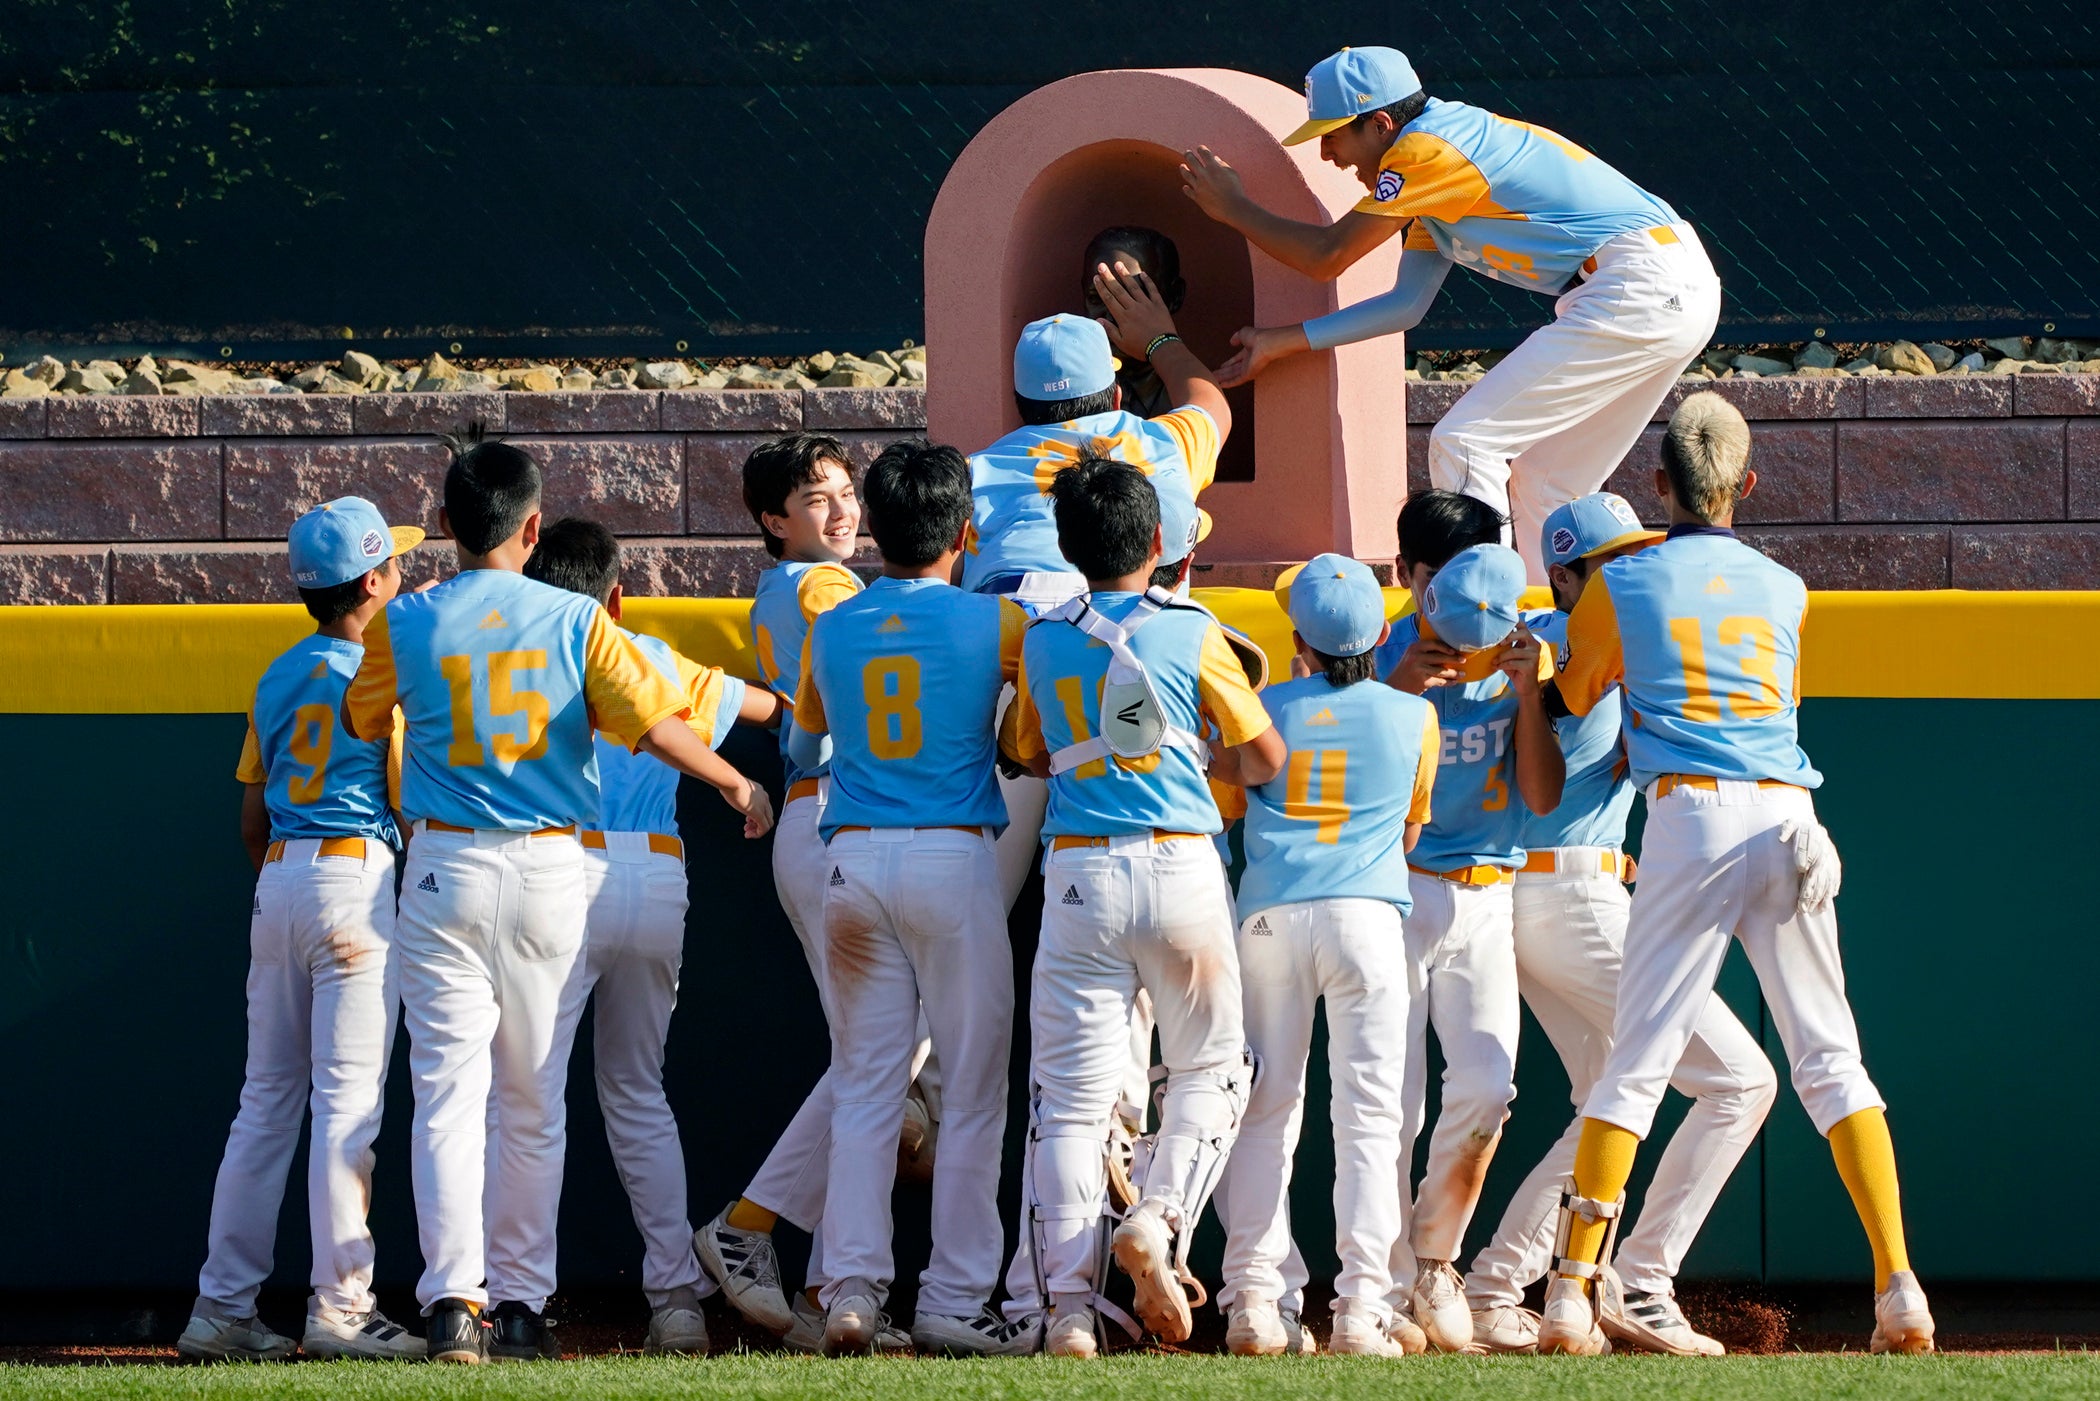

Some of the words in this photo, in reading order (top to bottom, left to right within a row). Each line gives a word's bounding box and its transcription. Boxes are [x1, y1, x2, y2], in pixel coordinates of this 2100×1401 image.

[1043, 378, 1070, 392] WEST
[296, 571, 317, 582] WEST
[1339, 638, 1366, 652] WEST
[1669, 616, 1782, 722] 13
[440, 649, 550, 767] 15
[862, 655, 923, 761] 8
[288, 703, 334, 804] 9
[1439, 718, 1511, 765] EST
[1285, 750, 1349, 845] 4
[1482, 761, 1509, 812] 5
[417, 883, 440, 894] adidas
[1061, 897, 1084, 906] adidas
